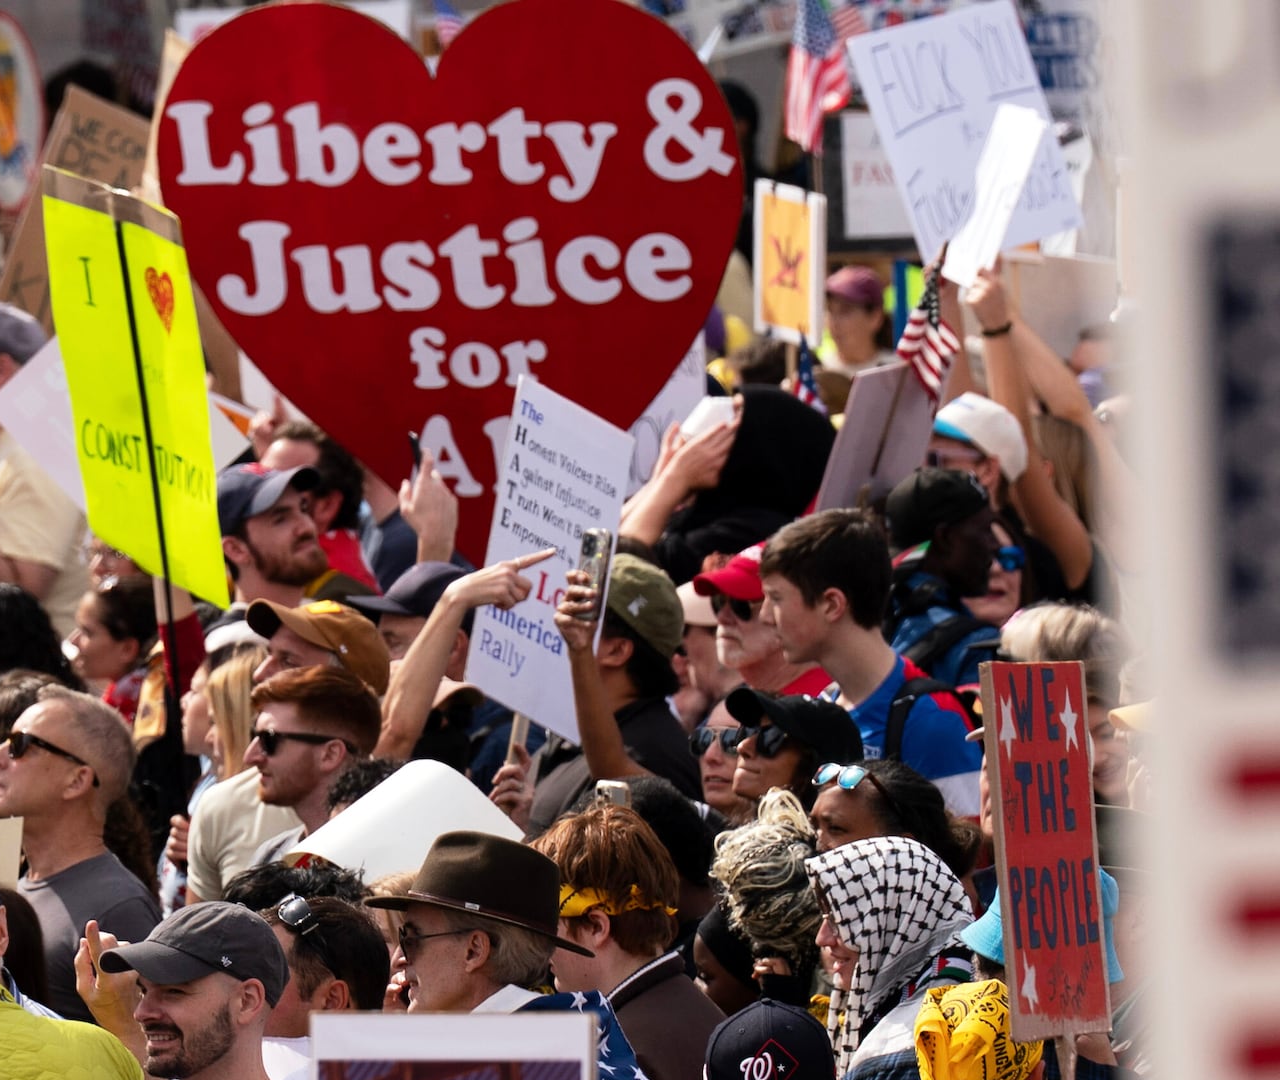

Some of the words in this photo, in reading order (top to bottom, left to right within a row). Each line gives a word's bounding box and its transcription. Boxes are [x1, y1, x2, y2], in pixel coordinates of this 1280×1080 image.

[167, 101, 618, 201] Liberty
[644, 78, 736, 181] &
[78, 255, 96, 308] I
[217, 217, 693, 316] Justice
[409, 327, 547, 389] for
[521, 399, 544, 427] The
[81, 417, 211, 504] CONSTTUTION
[479, 629, 527, 678] Rally
[1009, 667, 1060, 743] WE
[1014, 758, 1076, 834] THE
[1009, 856, 1098, 951] PEOPLE
